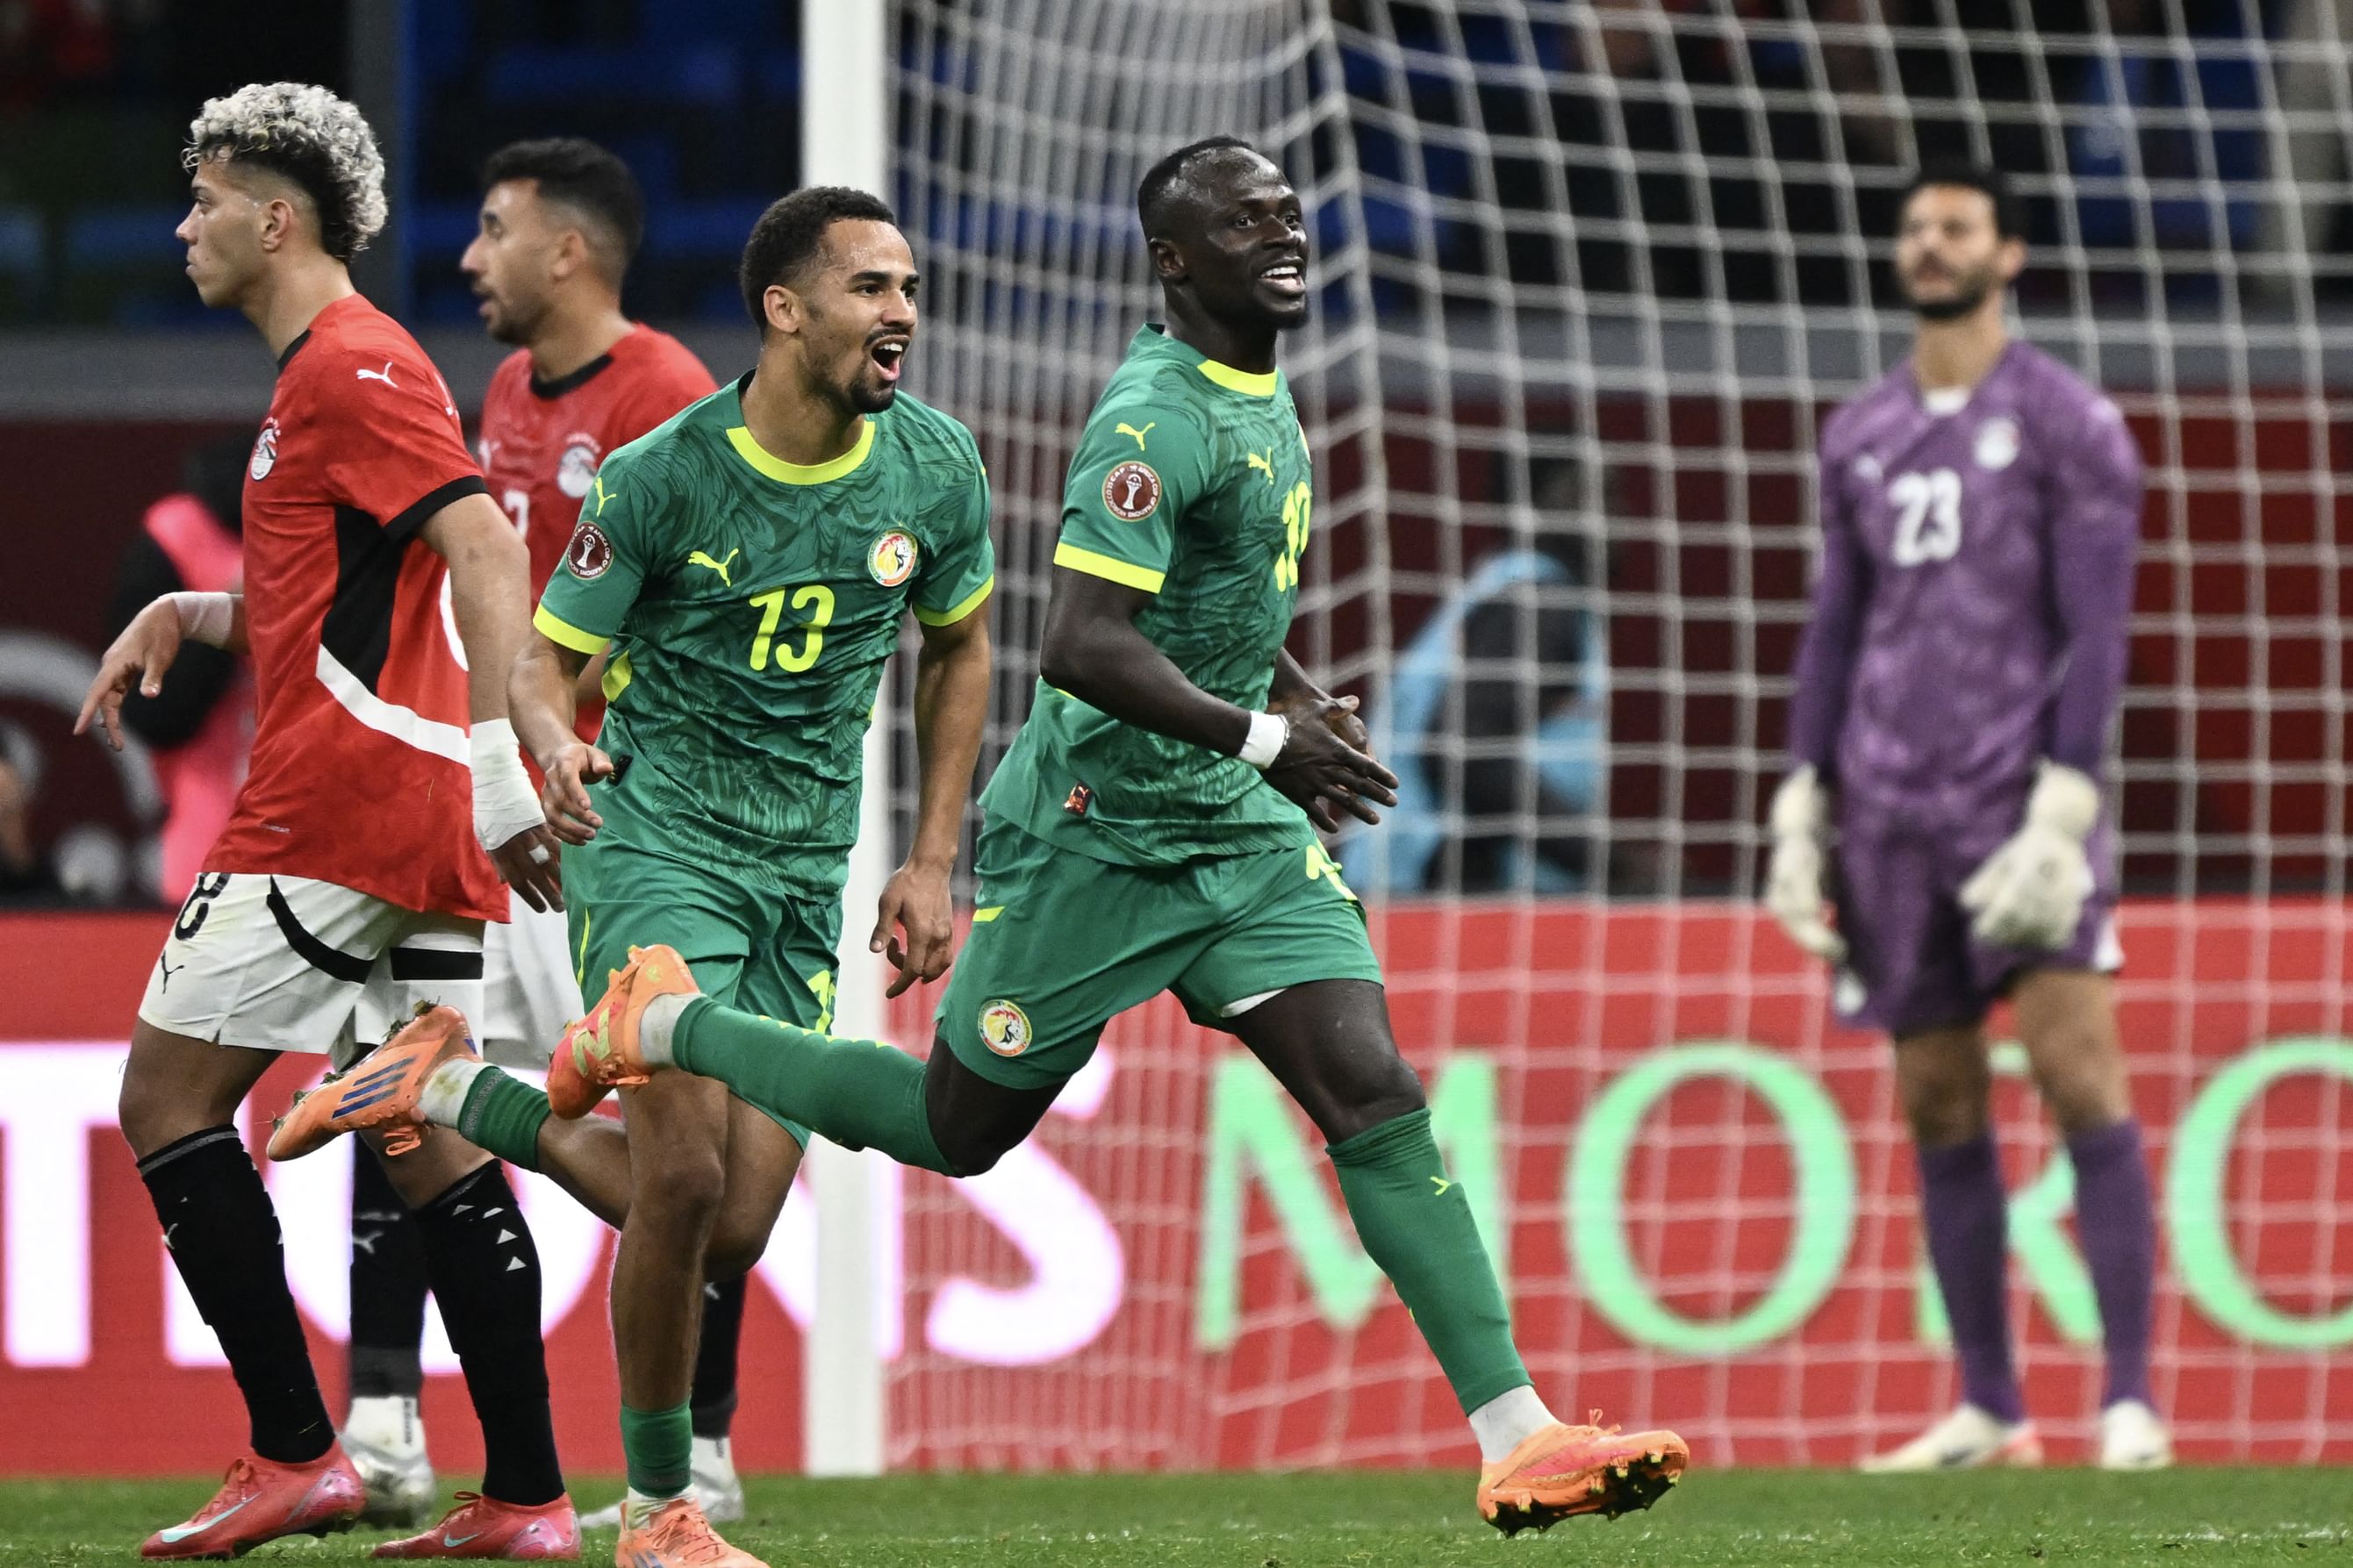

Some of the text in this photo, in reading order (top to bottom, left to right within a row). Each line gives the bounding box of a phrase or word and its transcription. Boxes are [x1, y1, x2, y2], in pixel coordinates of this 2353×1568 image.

[1890, 469, 1962, 567] 23
[749, 585, 836, 672] 13
[0, 1041, 1125, 1374] TOS
